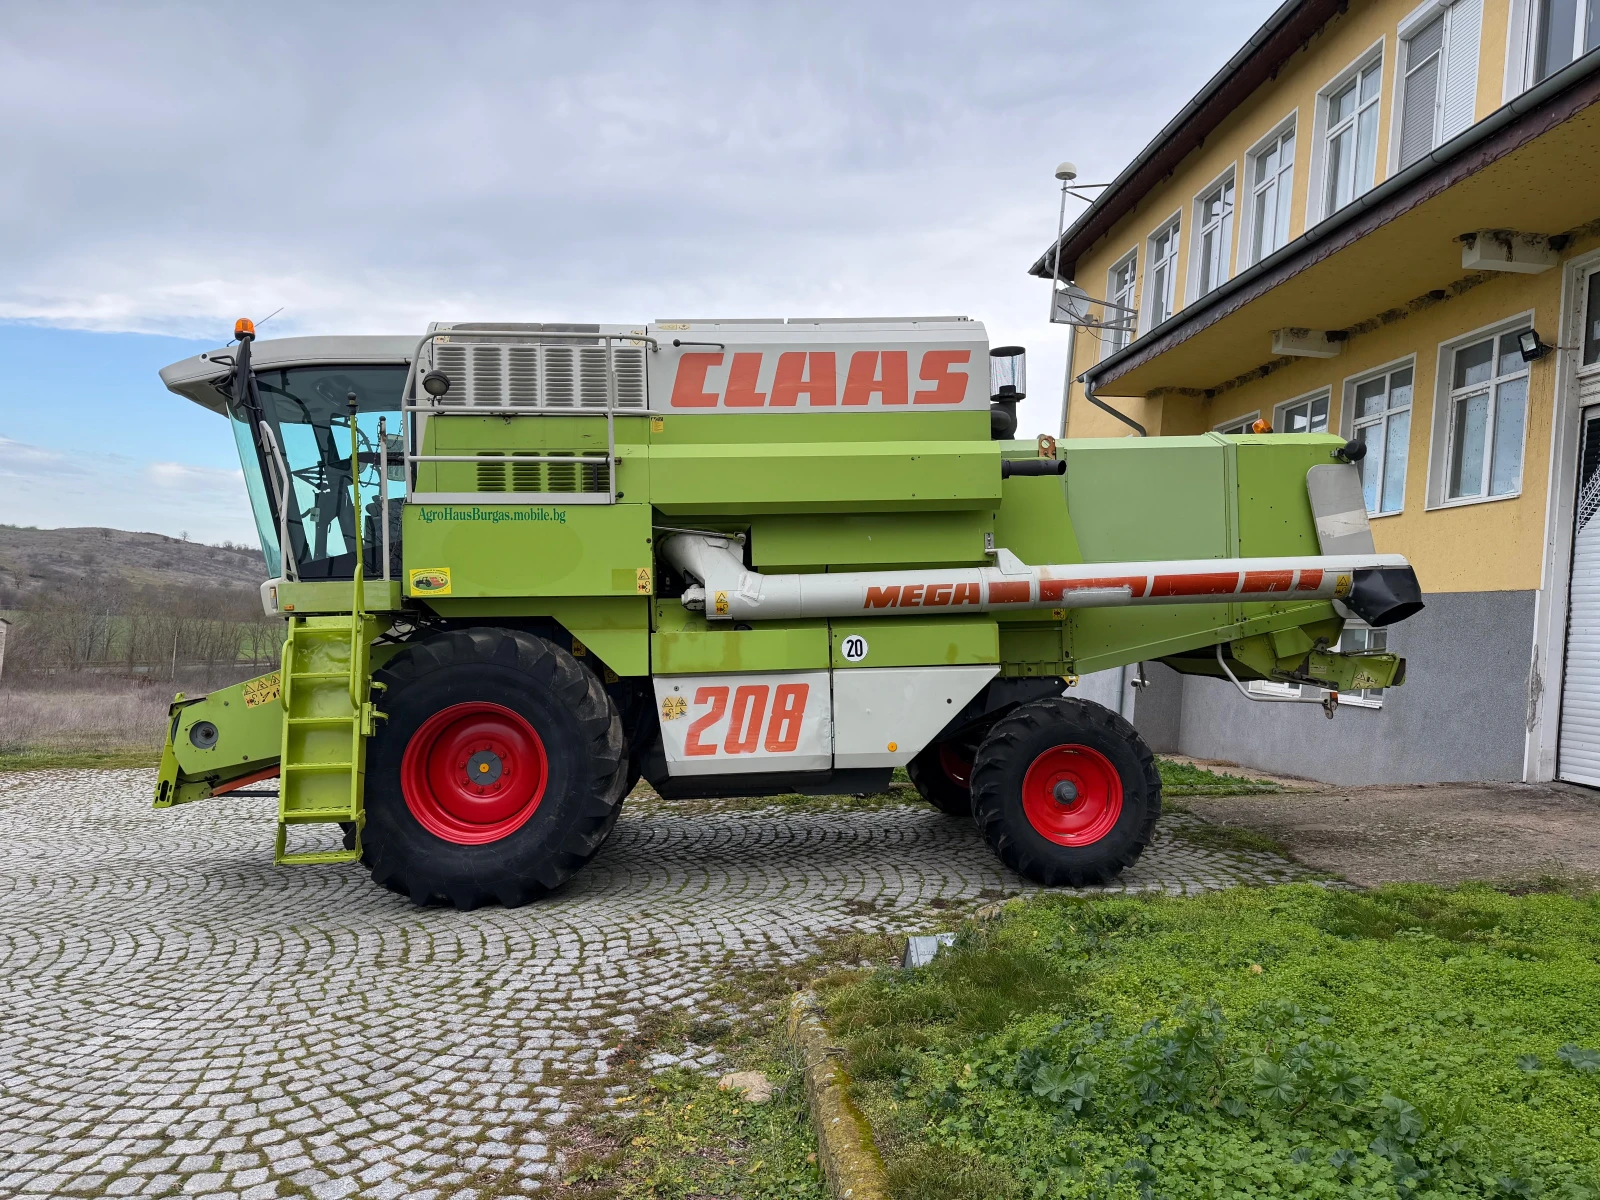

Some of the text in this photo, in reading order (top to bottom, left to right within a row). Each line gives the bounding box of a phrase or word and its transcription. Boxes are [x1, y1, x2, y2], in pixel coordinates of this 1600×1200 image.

[670, 350, 972, 407] CLAAS
[418, 507, 566, 523] AgroHausBurgas.mobile.bg
[863, 582, 980, 608] MEGA
[846, 639, 863, 657] 20
[684, 683, 810, 757] 208
